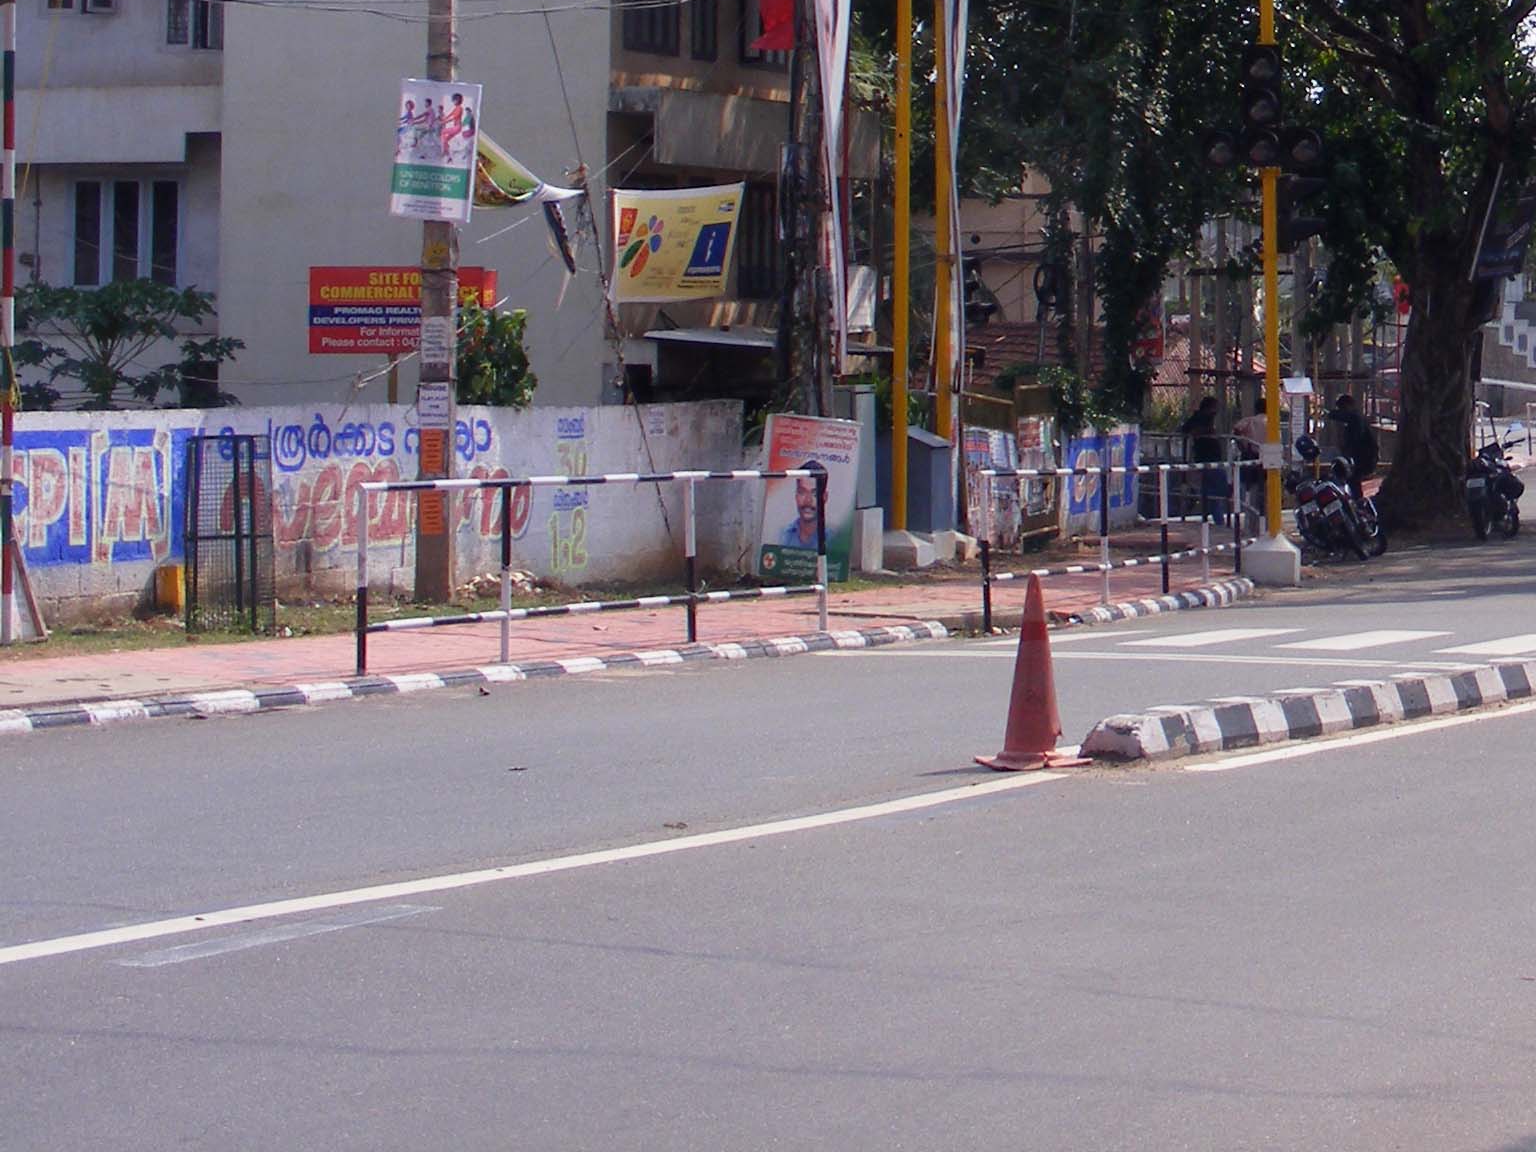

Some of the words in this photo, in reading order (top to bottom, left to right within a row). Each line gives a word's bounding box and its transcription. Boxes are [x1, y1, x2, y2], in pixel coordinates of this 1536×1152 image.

[369, 272, 400, 285] SITE
[402, 272, 422, 285] FO
[320, 286, 412, 298] COMMERCIAL
[333, 307, 383, 315] PROMAG
[389, 317, 421, 325] PRIVA
[360, 327, 376, 336] For
[379, 327, 420, 336] Informat
[321, 338, 354, 347] Please
[357, 338, 395, 346] contact
